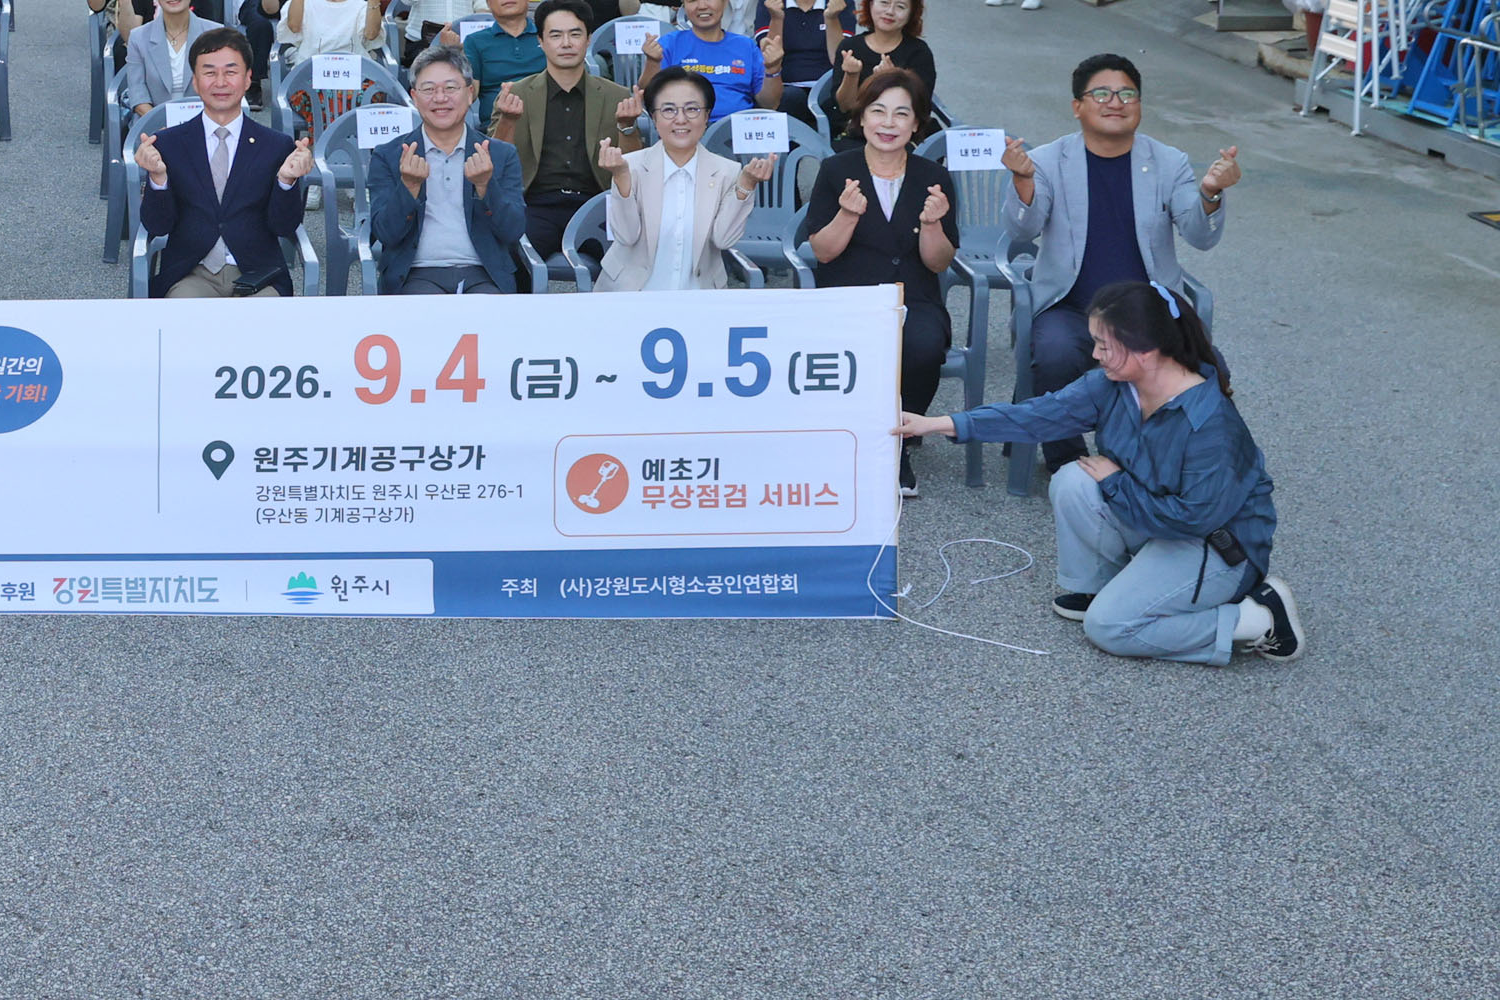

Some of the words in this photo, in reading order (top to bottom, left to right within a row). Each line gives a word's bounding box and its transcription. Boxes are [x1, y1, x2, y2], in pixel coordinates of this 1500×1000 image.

[322, 70, 350, 79] 내빈석
[369, 126, 401, 136] 내빈석
[743, 130, 776, 141] 내빈석
[959, 145, 993, 158] 내빈석
[213, 364, 333, 400] 2026.
[353, 332, 487, 404] 9.4
[509, 356, 580, 402] (금)
[639, 326, 772, 399] 9.5
[786, 349, 858, 395] (토)
[4, 382, 48, 403] 기회!
[253, 444, 487, 474] 원주기계공구상가
[640, 457, 721, 482] 예초기
[255, 483, 367, 502] 강원특별자치도
[371, 482, 420, 501] 원주시
[424, 482, 472, 501] 우산로
[476, 483, 524, 499] 276-1
[640, 484, 748, 511] 무상점검
[759, 482, 840, 508] 서비스
[255, 506, 309, 526] (우산동
[314, 504, 415, 526] 기계공구상가)
[0, 581, 36, 602] 후원
[51, 575, 220, 605] 강원특별자치도
[330, 574, 390, 602] 원주시
[500, 577, 538, 599] 주최
[559, 572, 800, 600] (사)강원도시형소공인연합회
